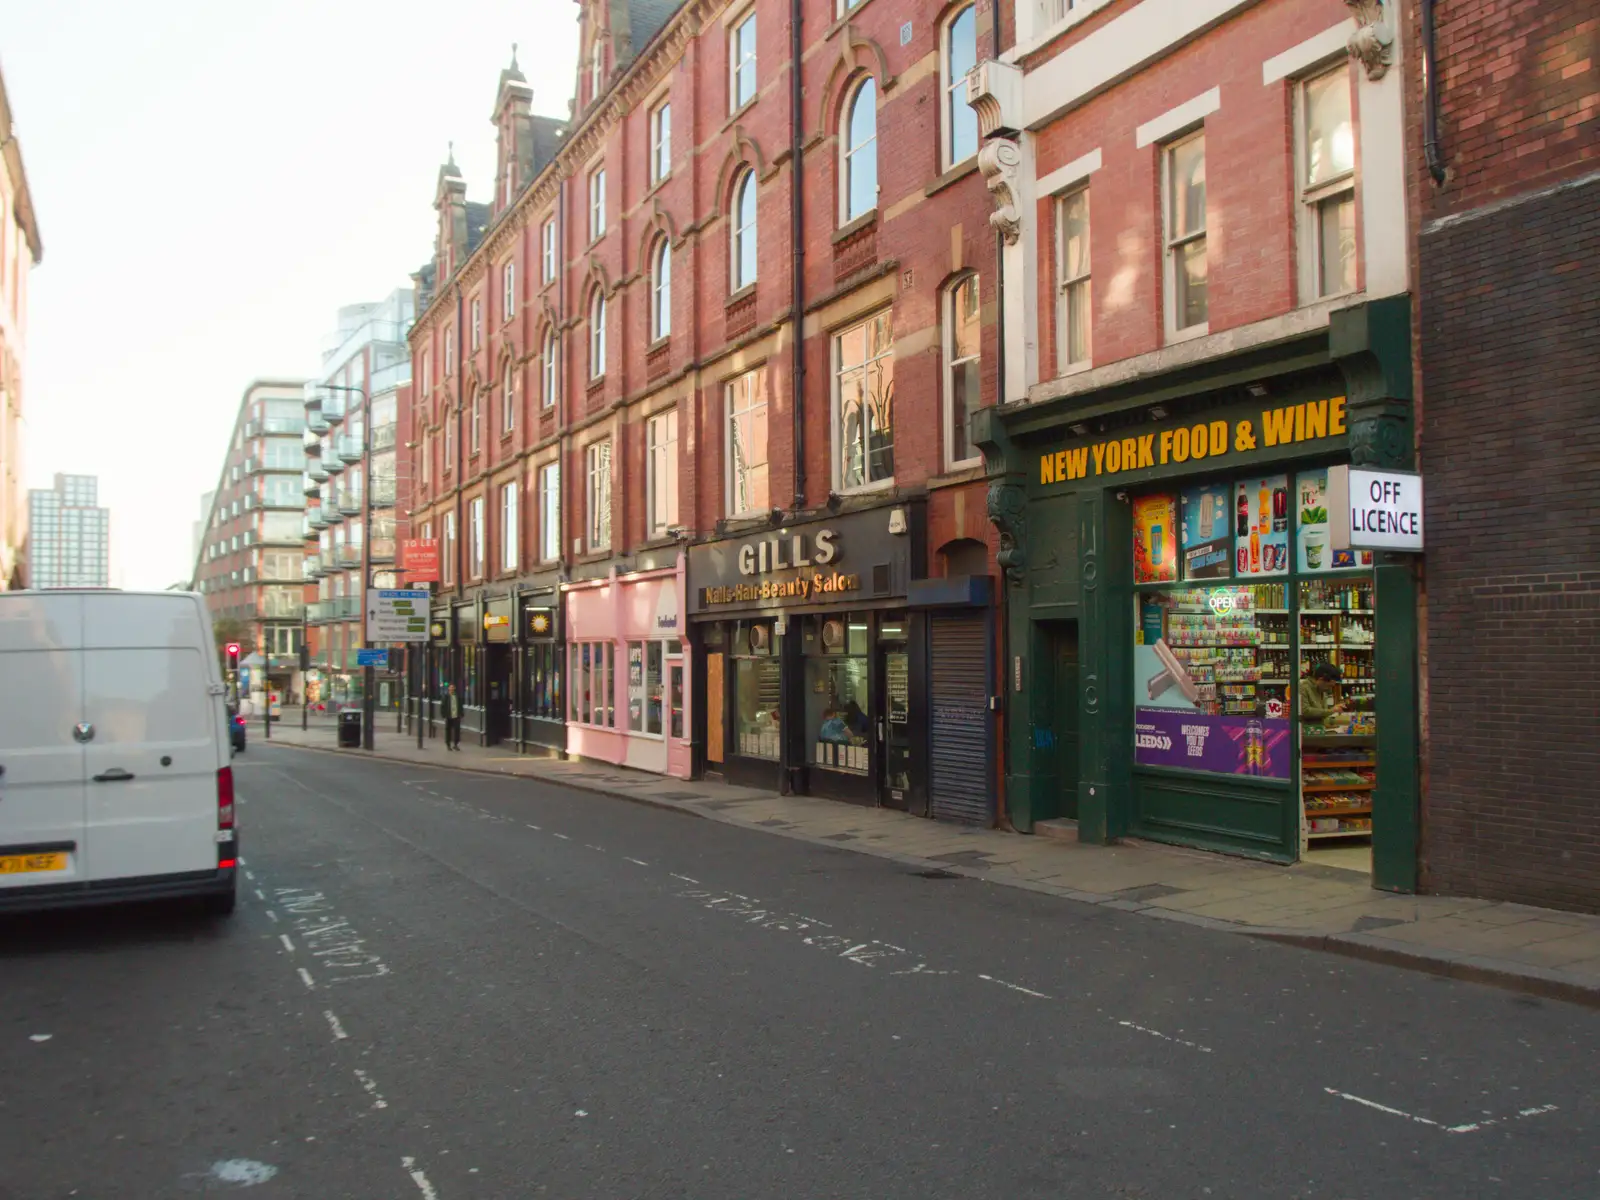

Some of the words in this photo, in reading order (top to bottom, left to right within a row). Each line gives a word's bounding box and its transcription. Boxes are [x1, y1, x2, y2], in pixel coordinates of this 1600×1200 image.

[1040, 446, 1088, 484] NEW
[1091, 434, 1155, 476] YORK
[1160, 420, 1228, 464] FOOD
[1235, 420, 1256, 451] &
[1262, 396, 1346, 447] WINE
[1370, 480, 1401, 505] OFF
[1352, 507, 1419, 535] LICENCE
[738, 529, 835, 575] GILLS
[814, 571, 859, 593] Salon
[1209, 598, 1236, 609] OPEN
[1181, 724, 1210, 737] WELCOMES
